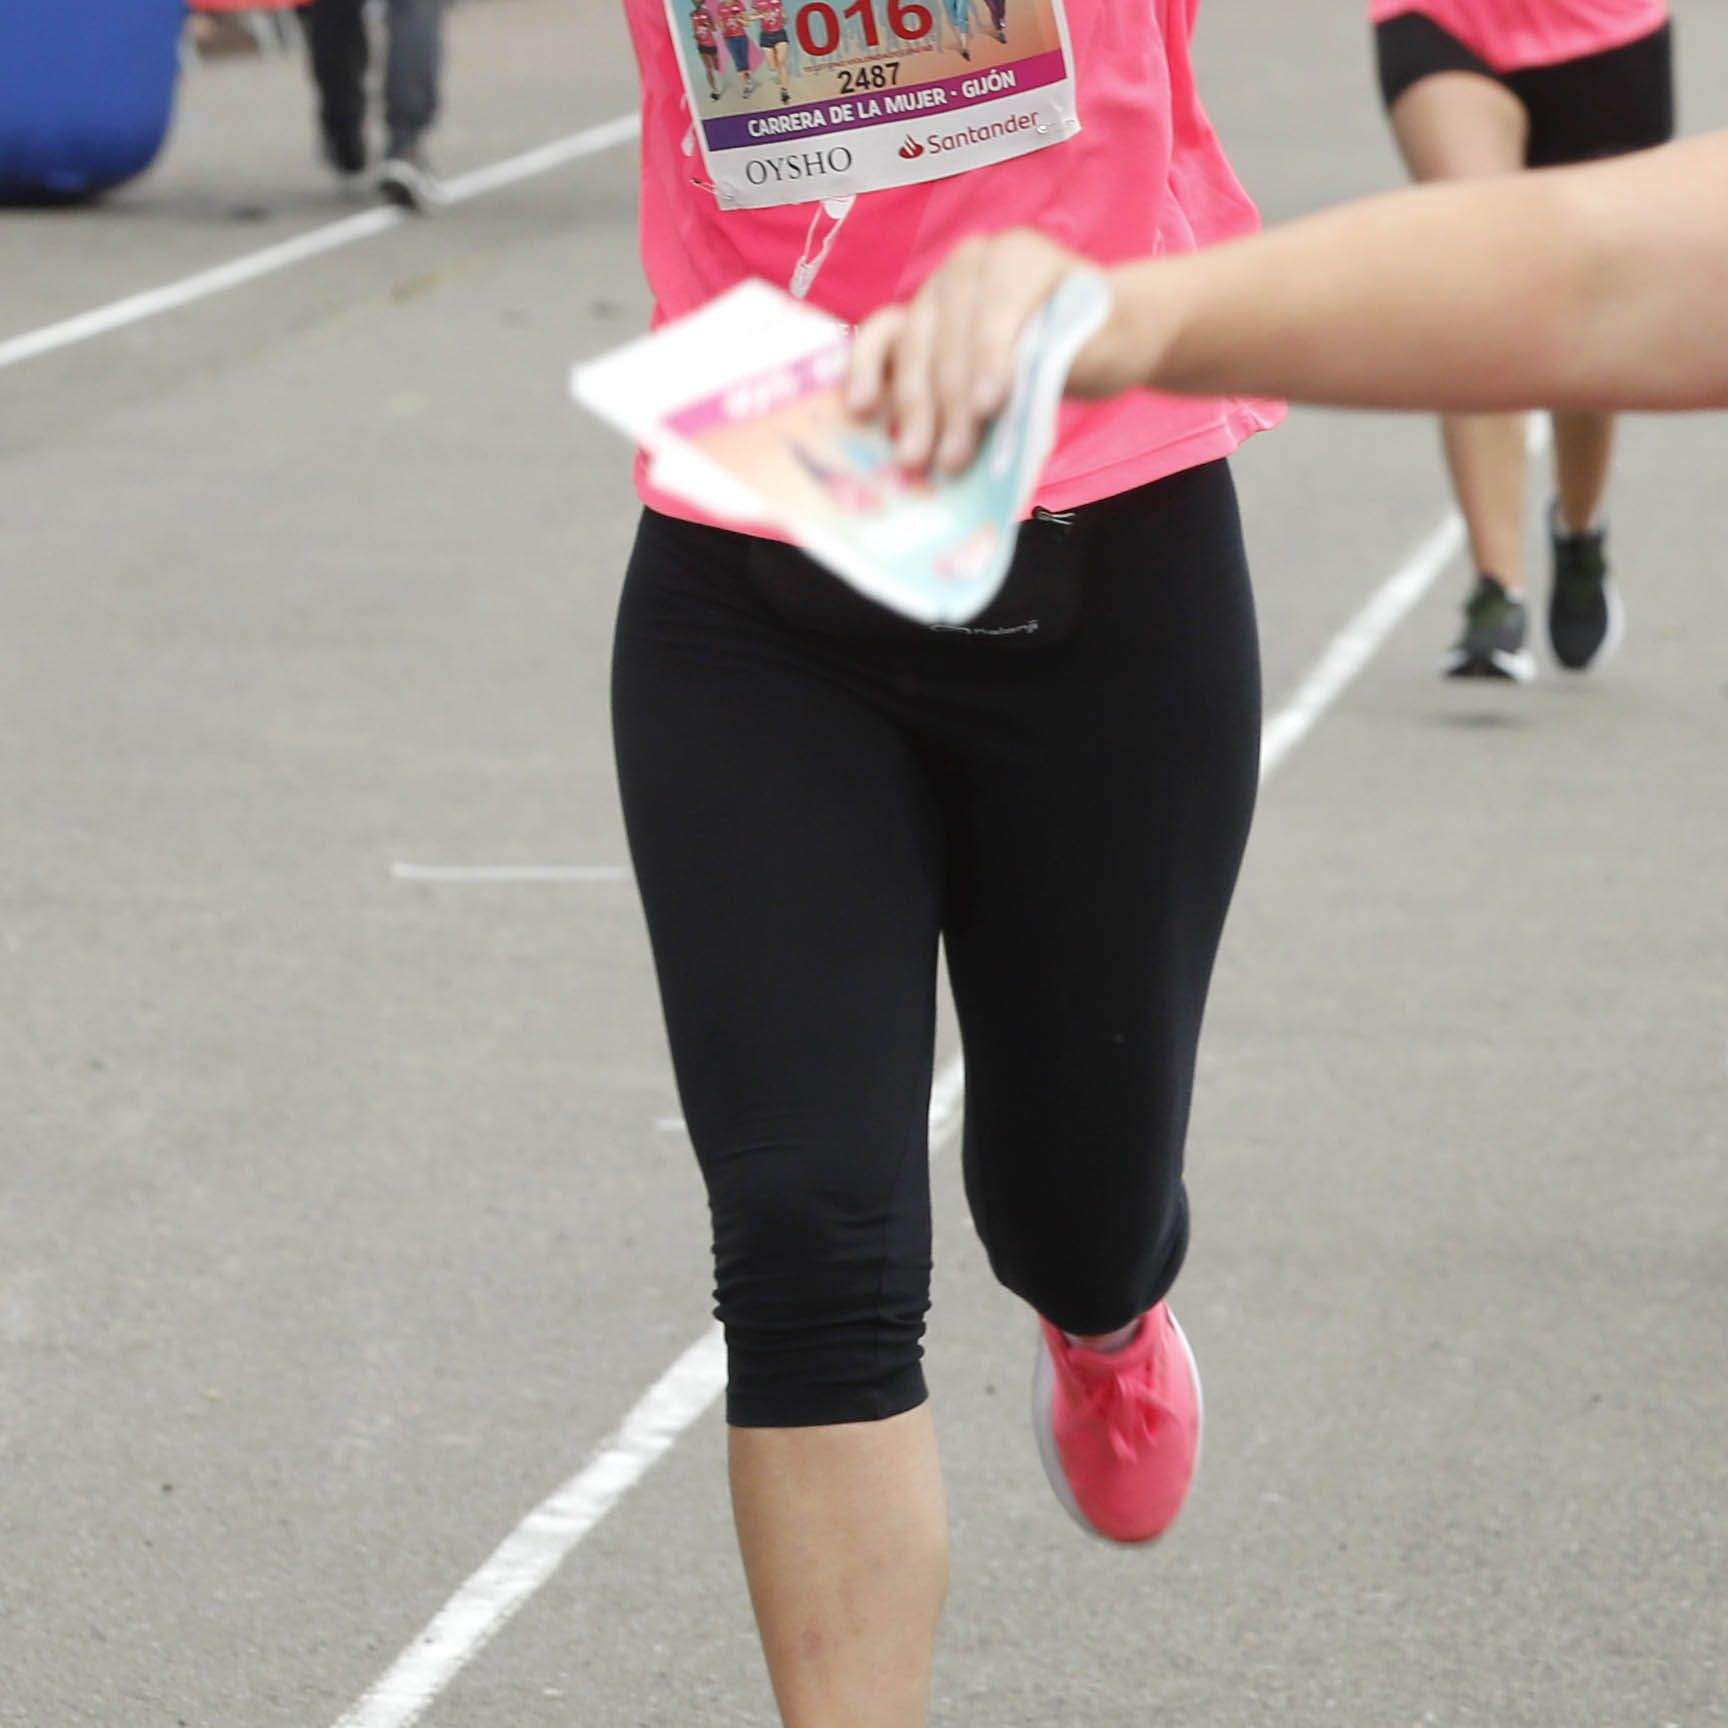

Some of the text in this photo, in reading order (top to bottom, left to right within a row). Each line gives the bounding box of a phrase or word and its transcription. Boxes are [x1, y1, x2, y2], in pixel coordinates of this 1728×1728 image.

[837, 61, 900, 95] 2487
[748, 108, 827, 138] CARRERA
[829, 103, 854, 123] DE
[858, 99, 881, 119] LA
[885, 87, 948, 115] MUJER
[962, 68, 1017, 100] GIJÓN
[928, 109, 1041, 155] Santander
[745, 146, 853, 186] OYSHO
